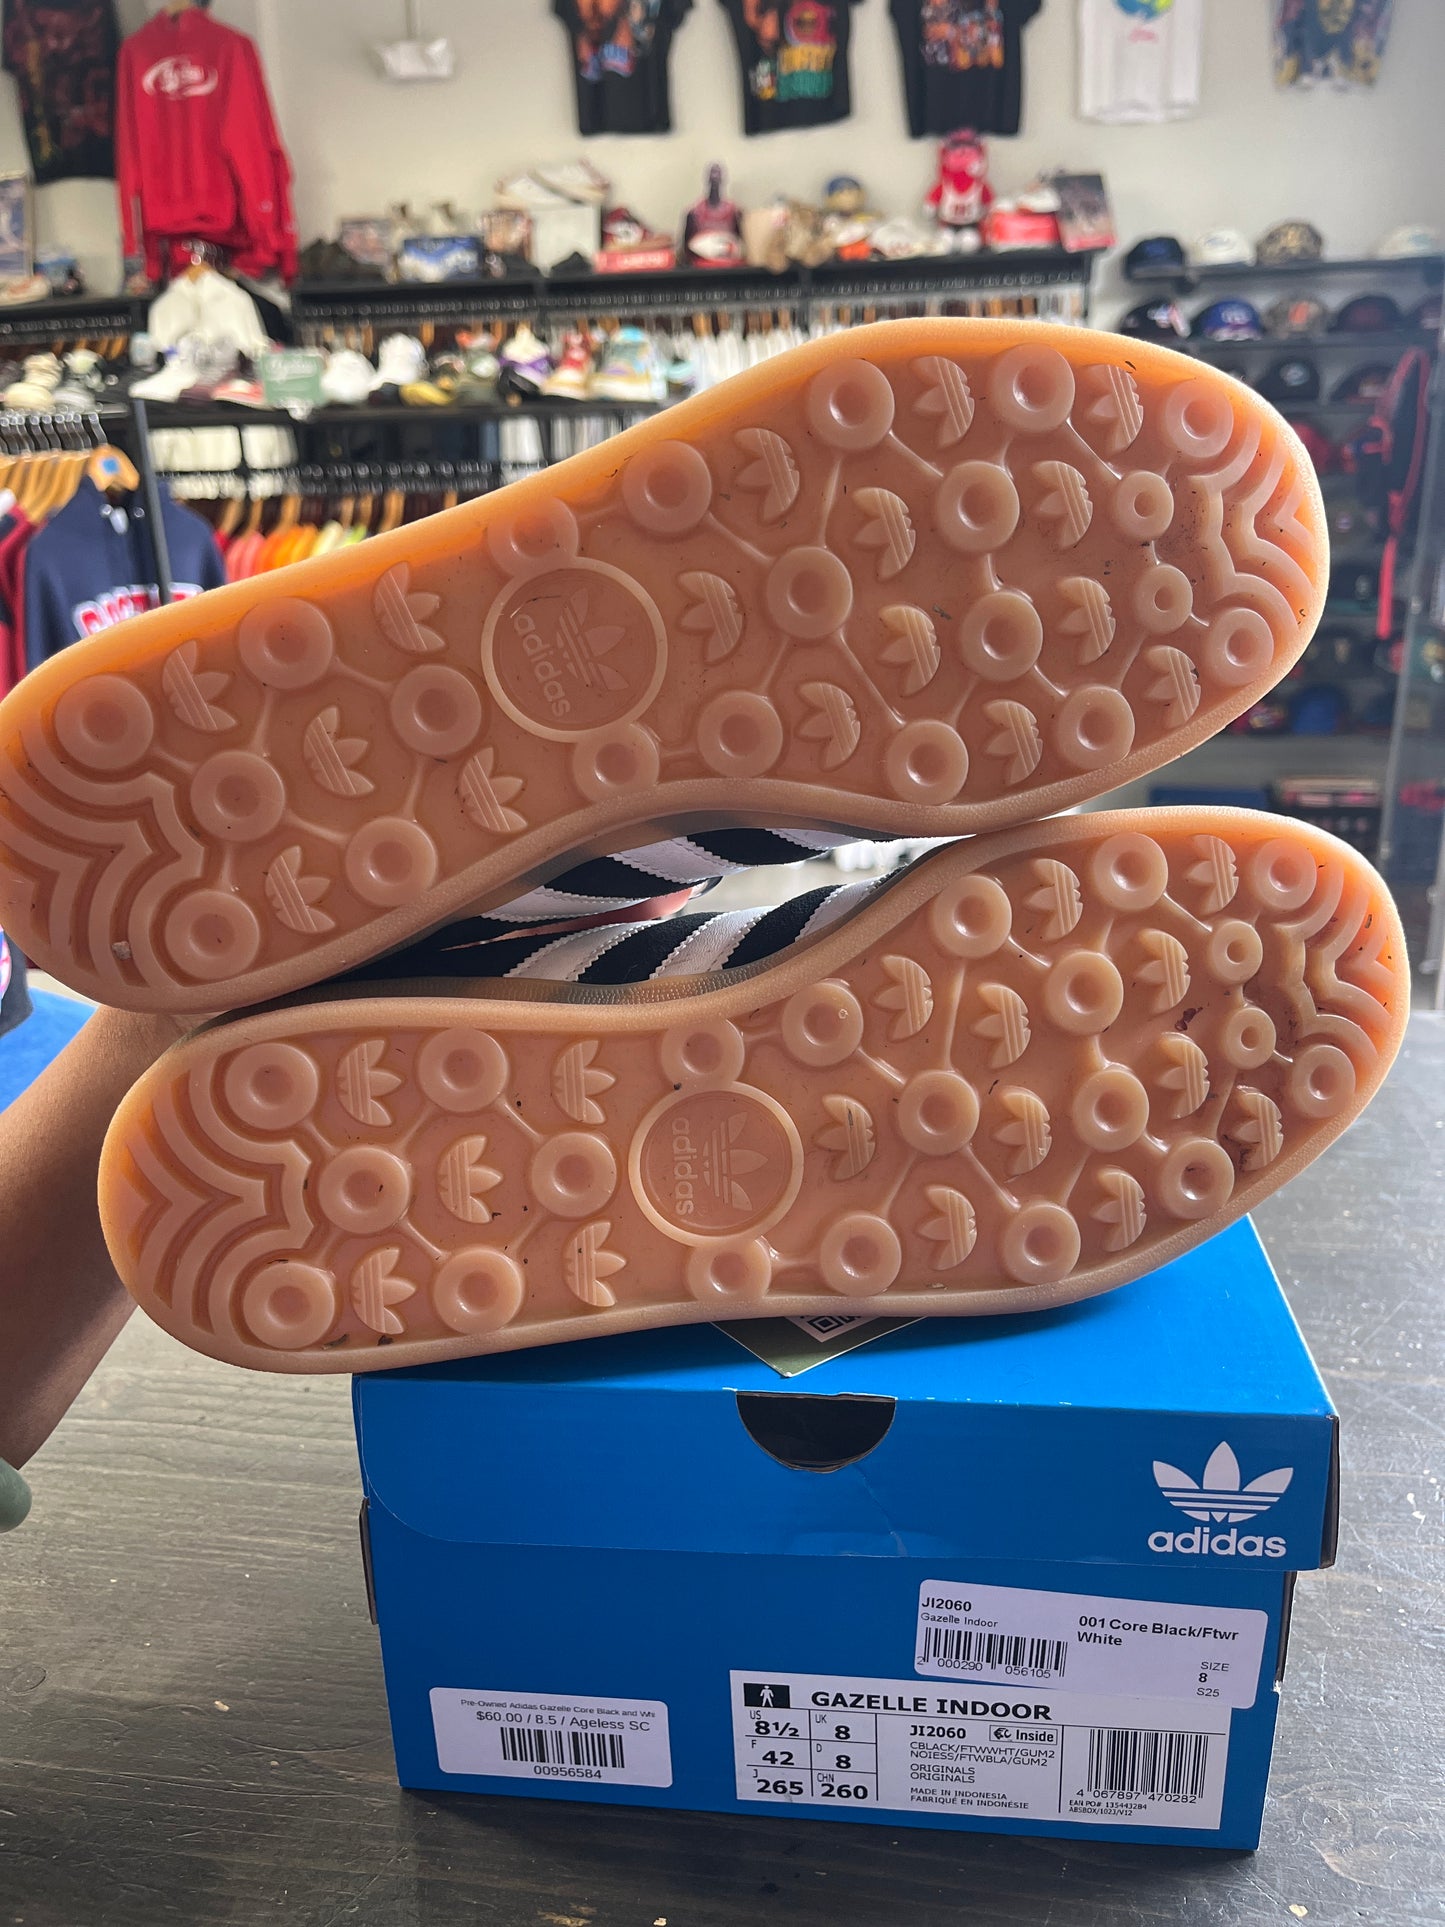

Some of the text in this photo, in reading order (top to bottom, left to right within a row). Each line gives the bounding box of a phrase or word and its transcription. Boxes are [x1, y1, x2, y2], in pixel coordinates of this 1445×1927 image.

[513, 613, 571, 717] adidas
[672, 1117, 698, 1216] adidas
[1148, 1526, 1287, 1558] adidas
[922, 1597, 972, 1612] JI2060
[921, 1612, 999, 1628] Gazelle Indoor
[1079, 1615, 1239, 1641] 001 Core Black/Ftwr
[1077, 1631, 1123, 1646] White
[937, 1658, 983, 1672] 000290
[1005, 1666, 1051, 1679] 056105
[1200, 1661, 1230, 1672] SIZE
[1198, 1673, 1207, 1683] 8
[1197, 1687, 1220, 1698] S25
[461, 1699, 507, 1708] Pre-Owned
[510, 1702, 538, 1710] Adidas
[540, 1704, 571, 1712] Gazelle
[573, 1706, 594, 1714] Core
[811, 1691, 1053, 1720] GAZELLE INDOOR
[476, 1710, 523, 1723] $60.00
[535, 1714, 557, 1725] 8.5
[570, 1716, 625, 1730] Ageless
[629, 1720, 650, 1732] SC
[750, 1710, 761, 1720] US
[815, 1714, 827, 1724] UK
[834, 1725, 851, 1740] 8
[910, 1724, 966, 1739] JI2060
[1016, 1729, 1054, 1742] Inside
[751, 1739, 757, 1749] F
[816, 1743, 823, 1753] D
[762, 1750, 795, 1766] 42
[835, 1754, 852, 1770] 8
[534, 1765, 602, 1779] 00956584
[753, 1769, 758, 1779] J
[910, 1763, 976, 1775] ORIGINALS
[817, 1773, 834, 1783] CHN
[910, 1772, 976, 1783] ORIGINALS
[757, 1779, 803, 1796] 265
[821, 1783, 868, 1800] 260
[910, 1787, 937, 1795] MADE
[954, 1790, 1007, 1800] INDONESIA
[1076, 1789, 1197, 1804] 4 067897 470282
